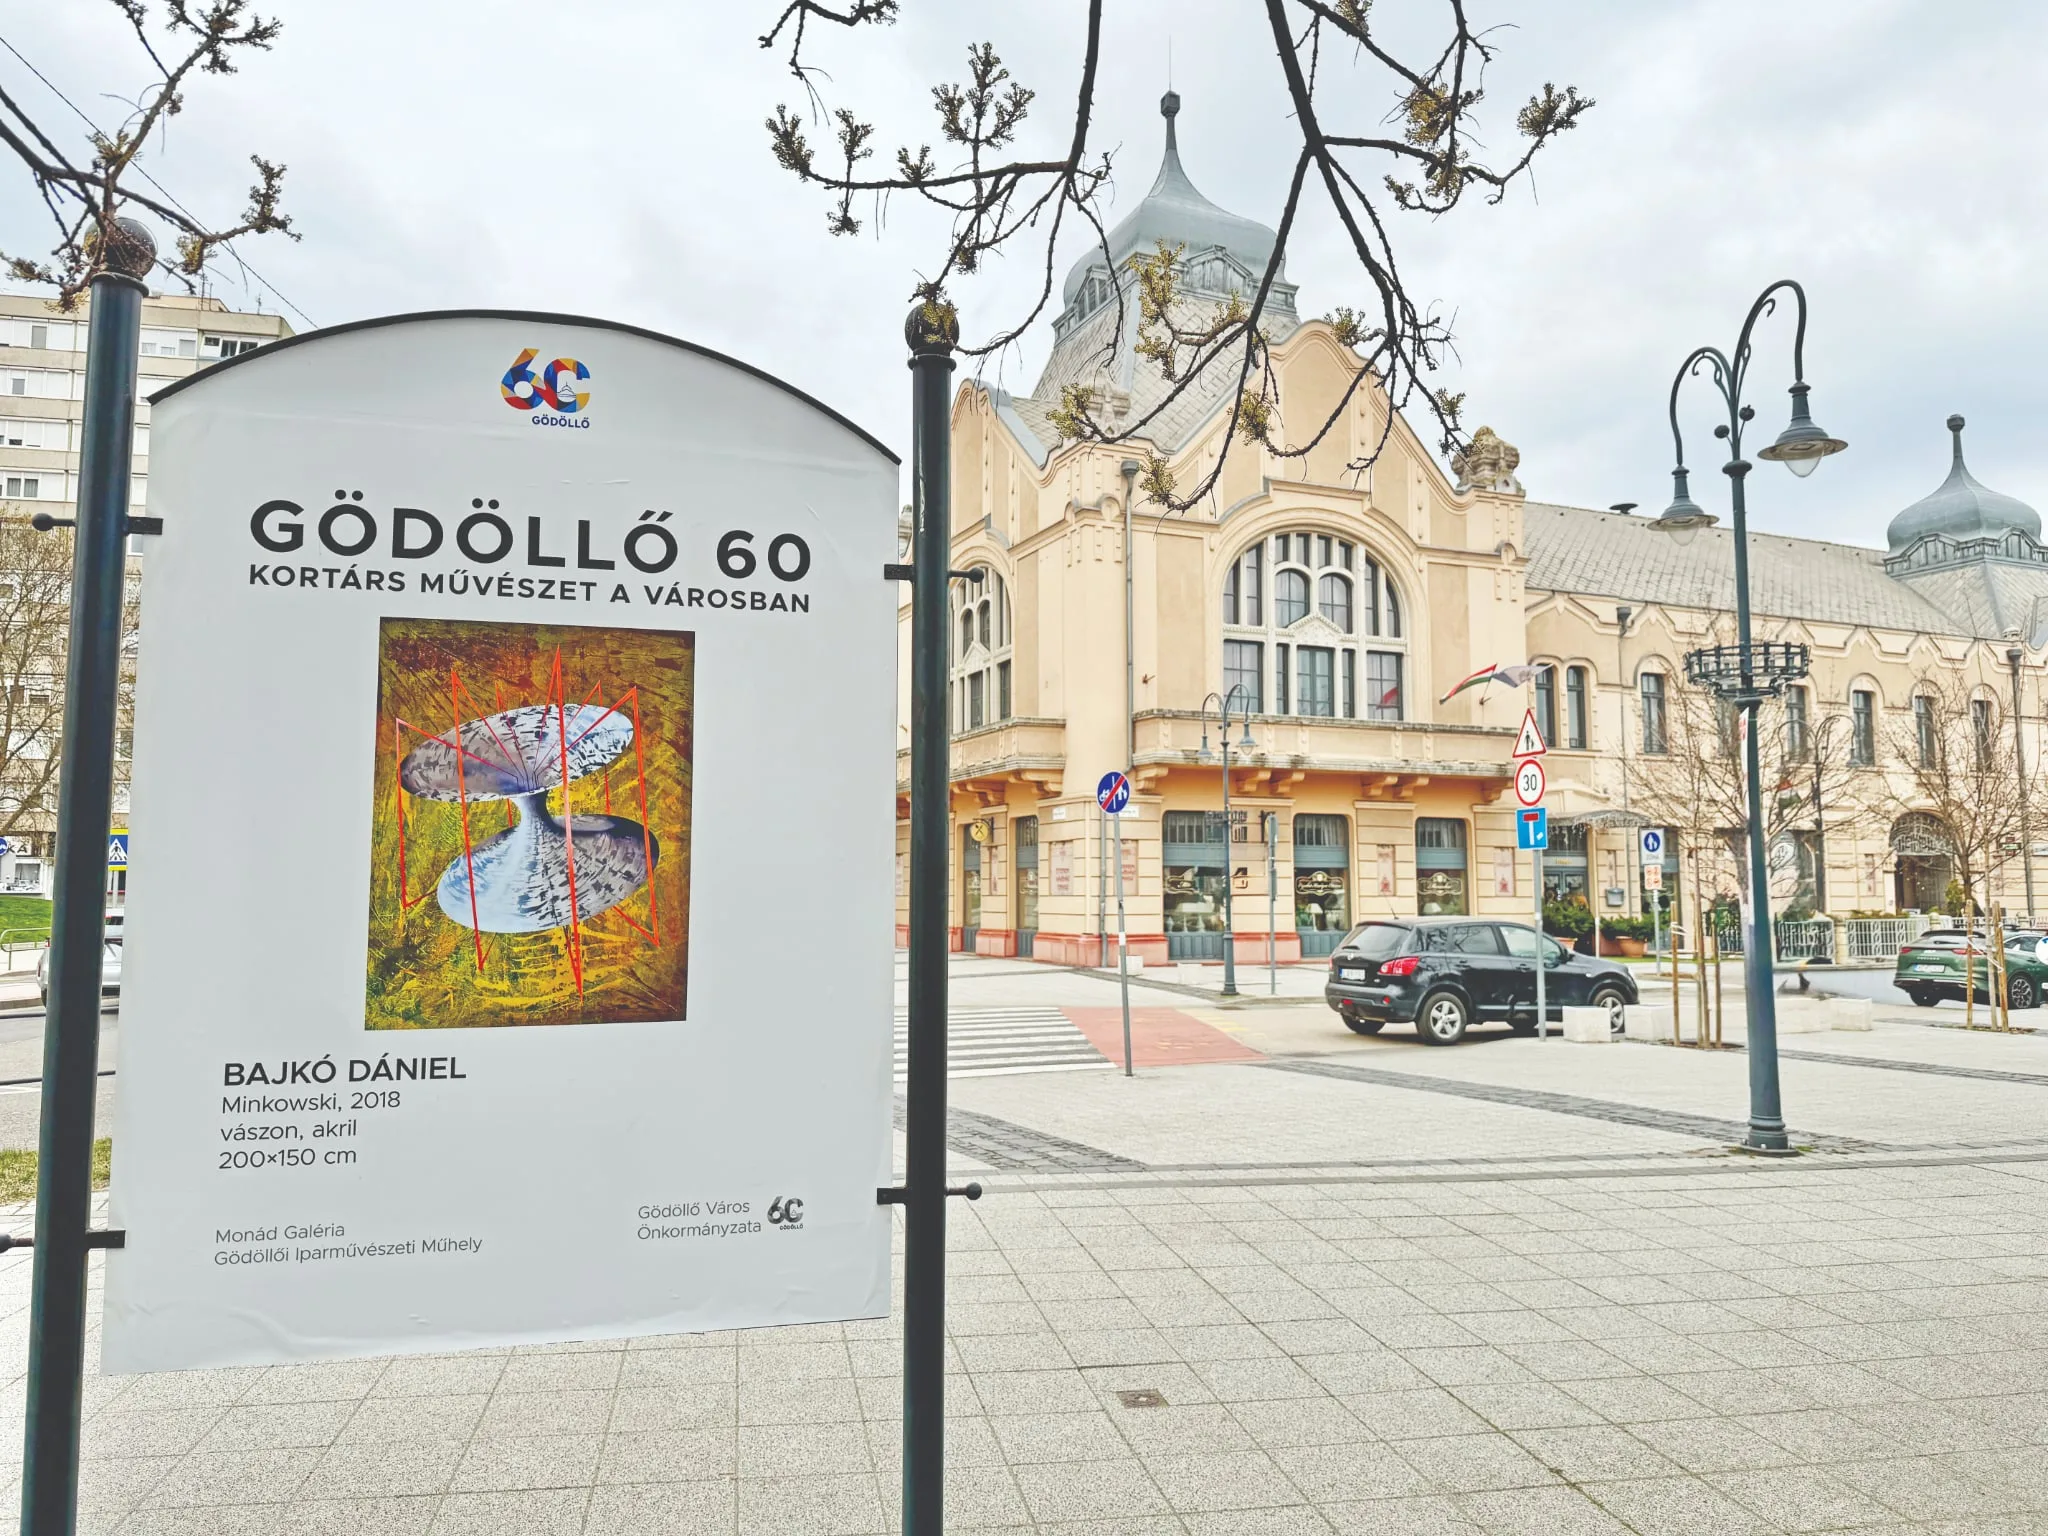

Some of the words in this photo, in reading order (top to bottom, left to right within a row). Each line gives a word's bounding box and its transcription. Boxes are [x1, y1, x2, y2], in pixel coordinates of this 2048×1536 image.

[250, 489, 679, 574] GÖDÖLLŐ
[717, 530, 810, 582] 60
[250, 564, 405, 591] KORTÁRS
[420, 567, 597, 602] MŰVÉSZET
[610, 584, 630, 603] A
[644, 581, 810, 613] VÁROSBAN
[1523, 774, 1537, 791] 30
[224, 1054, 336, 1086] BAJKÓ
[349, 1053, 466, 1082] DÁNIEL
[223, 1093, 341, 1113] Minkowski,
[351, 1091, 400, 1109] 2018
[221, 1124, 303, 1141] vászon,
[313, 1120, 356, 1137] akril
[324, 1151, 356, 1164] cm
[638, 1203, 700, 1219] Gödöllő
[706, 1201, 749, 1214] Város
[216, 1227, 277, 1243] Monád
[284, 1223, 344, 1239] Galéria
[638, 1220, 761, 1239] Önkormányzata
[215, 1248, 288, 1265] Gödöllői
[296, 1240, 415, 1263] Iparművészeti
[422, 1237, 482, 1253] Műhely
